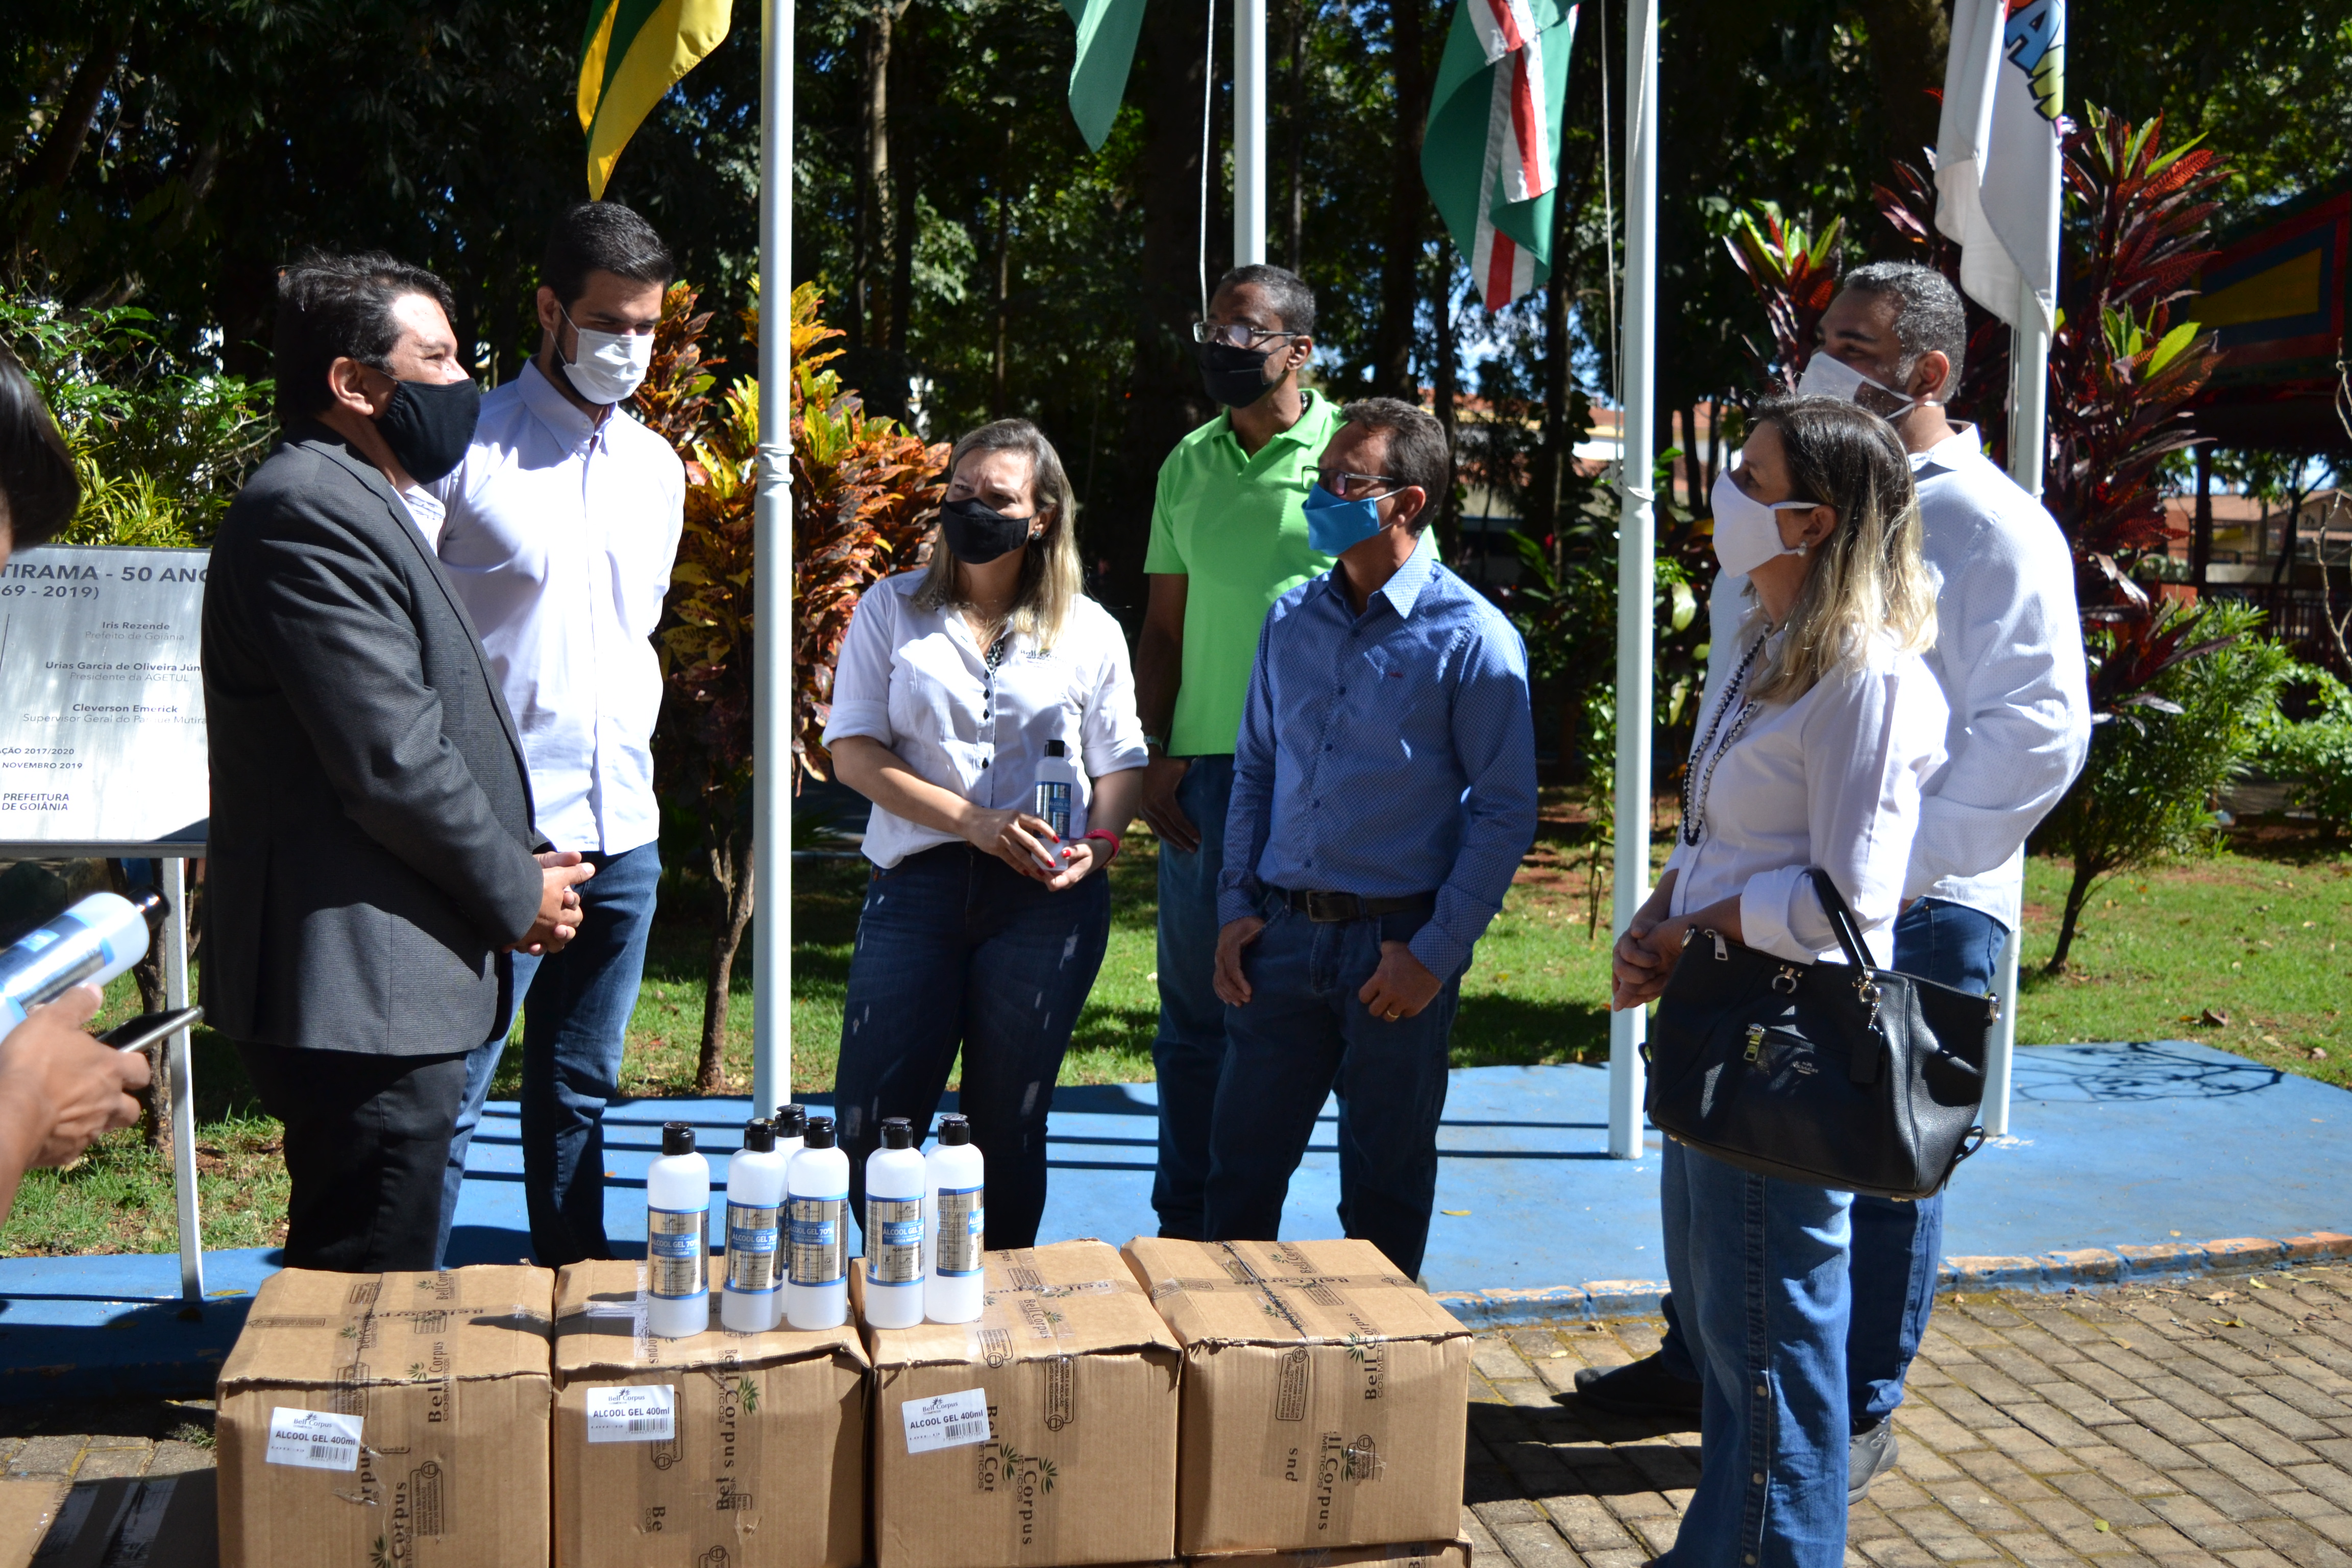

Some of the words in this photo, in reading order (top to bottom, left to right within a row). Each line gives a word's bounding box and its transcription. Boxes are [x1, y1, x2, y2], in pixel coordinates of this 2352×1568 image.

[121, 567, 153, 581] 50
[0, 584, 26, 596] 69
[43, 586, 99, 600] 2019)
[85, 631, 125, 640] Prefeito
[128, 631, 141, 640] de
[144, 632, 185, 641] Goiânia
[133, 663, 177, 672] Oliveira
[70, 672, 126, 681] Presidente
[129, 673, 142, 681] da
[144, 674, 189, 682] AGETUL
[72, 704, 129, 712] Cleverson
[133, 705, 178, 714] Emerick
[23, 714, 81, 724] Supervisor
[84, 715, 113, 723] Geral
[0, 747, 21, 755] ÇÃO
[3, 793, 69, 801] PREFEITURA
[20, 801, 68, 811] GOIÂNIA
[732, 1231, 754, 1242] ÁLCOOL
[883, 1227, 907, 1235] ÁLCOOL
[1024, 1299, 1039, 1312] Bell
[1032, 1312, 1052, 1339] Corpus
[1346, 1313, 1377, 1350] Corpus
[429, 1341, 448, 1373] Corpus
[1364, 1359, 1377, 1400] Bell
[594, 1409, 625, 1417] ALCOOL
[646, 1407, 670, 1415] 400ml
[922, 1404, 935, 1412] Bell
[309, 1419, 332, 1428] Corpus
[910, 1417, 941, 1429] ALCOOL
[943, 1414, 959, 1423] GEL
[961, 1410, 983, 1420] 400ml
[721, 1390, 739, 1468] Corpus
[276, 1431, 309, 1441] ALCOOL
[312, 1434, 328, 1443] GEL
[331, 1436, 355, 1446] 400ml
[1317, 1433, 1329, 1488] MÉTICOS
[985, 1456, 998, 1492] Cor
[1317, 1458, 1338, 1530] Corpus
[1019, 1471, 1037, 1545] Corpus
[392, 1482, 409, 1559] Corpus
